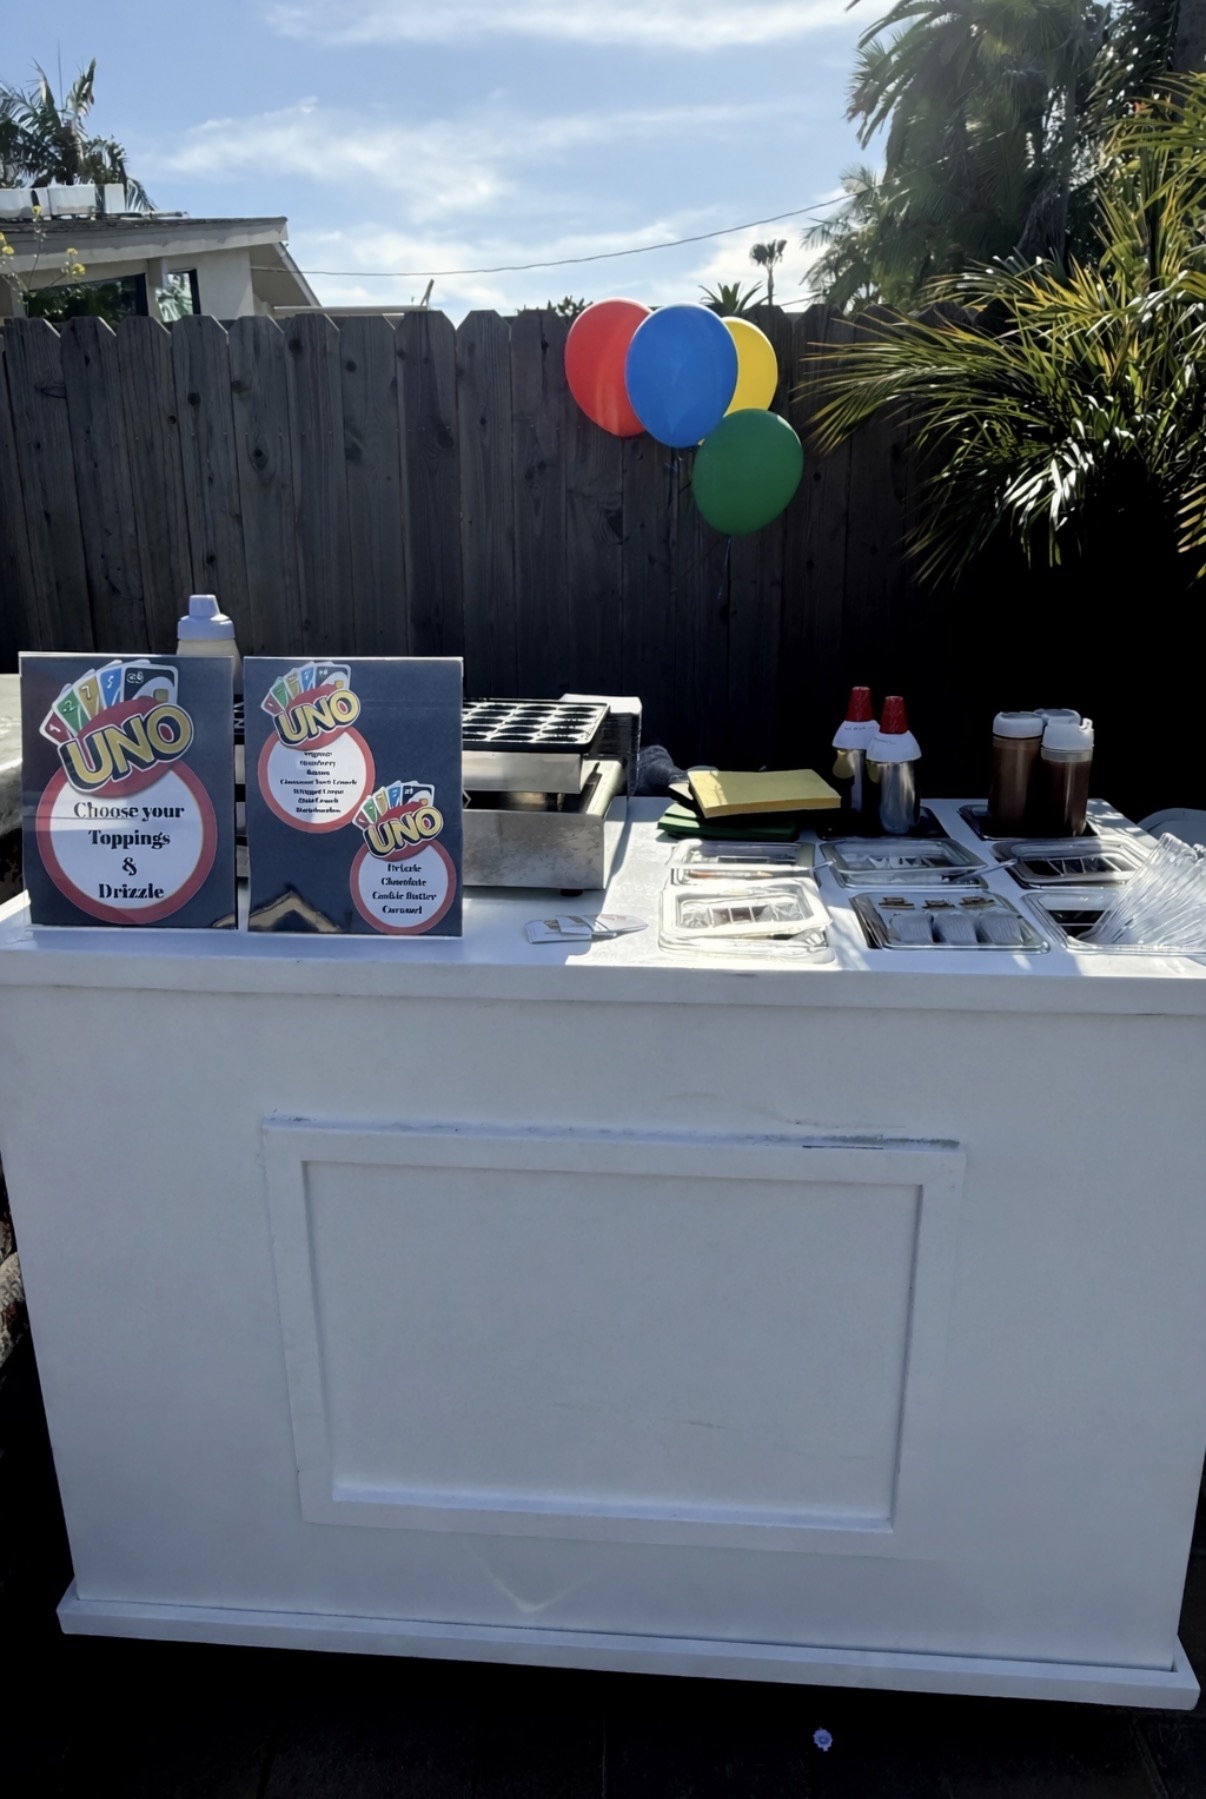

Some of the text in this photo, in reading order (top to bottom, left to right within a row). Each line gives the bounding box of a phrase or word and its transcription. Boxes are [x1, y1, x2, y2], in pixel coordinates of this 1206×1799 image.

[276, 690, 361, 744] UNO
[64, 705, 193, 788] UNO
[73, 801, 185, 825] Choose your
[88, 829, 171, 850] Toppings
[366, 808, 442, 854] UNO
[122, 857, 138, 876] &
[97, 883, 165, 900] Drizzle
